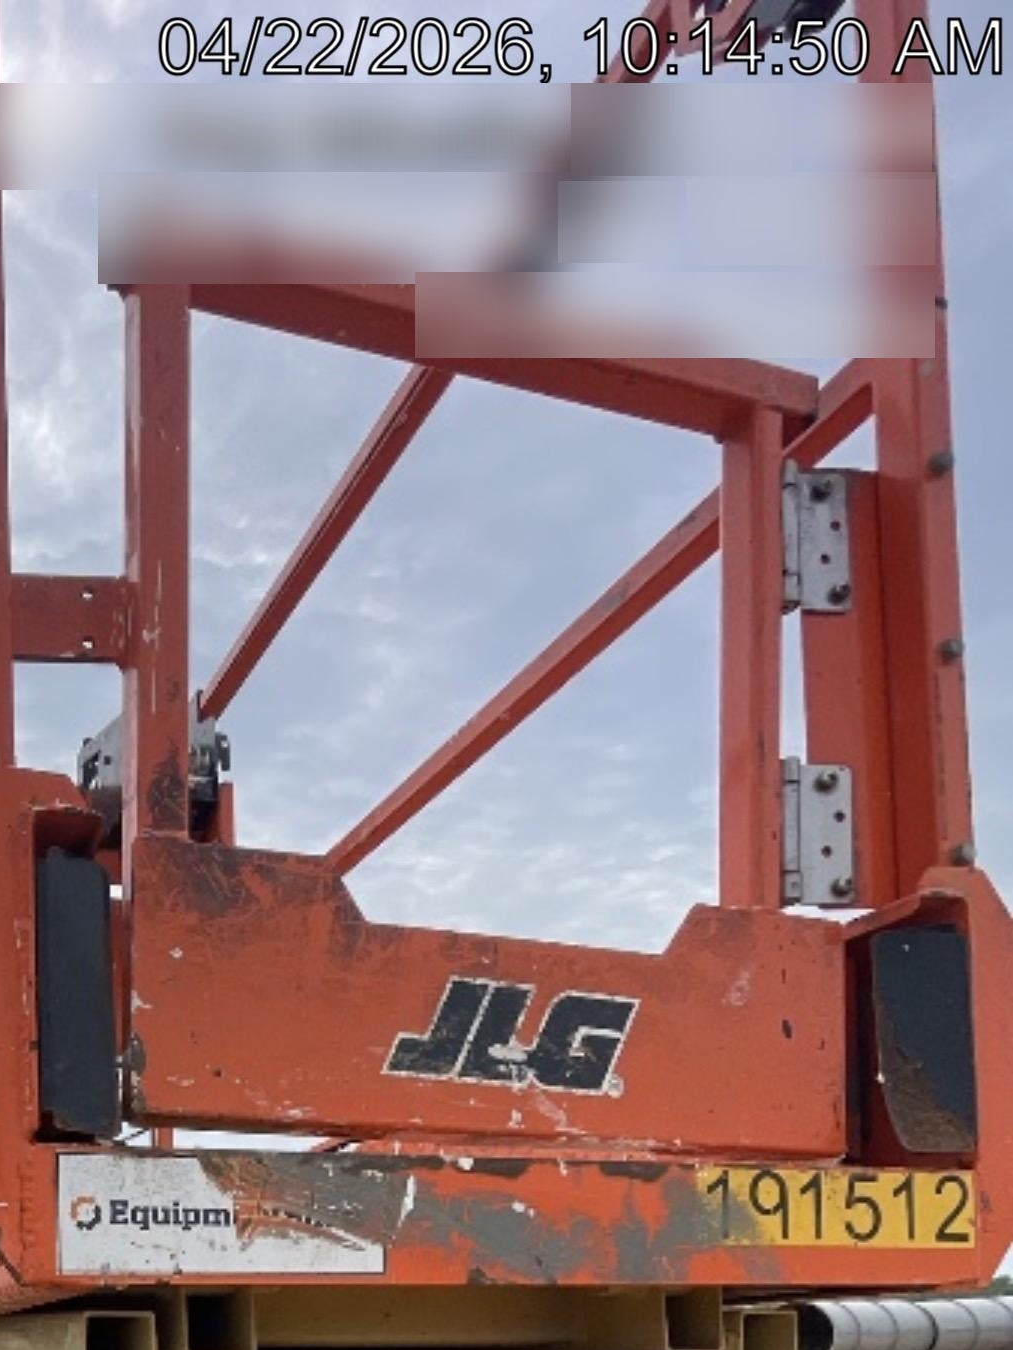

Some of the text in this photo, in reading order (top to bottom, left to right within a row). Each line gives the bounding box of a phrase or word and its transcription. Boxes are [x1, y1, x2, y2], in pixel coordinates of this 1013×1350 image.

[380, 975, 642, 1096] JLG
[109, 1199, 238, 1231] Equipm
[706, 1169, 970, 1243] 191512
